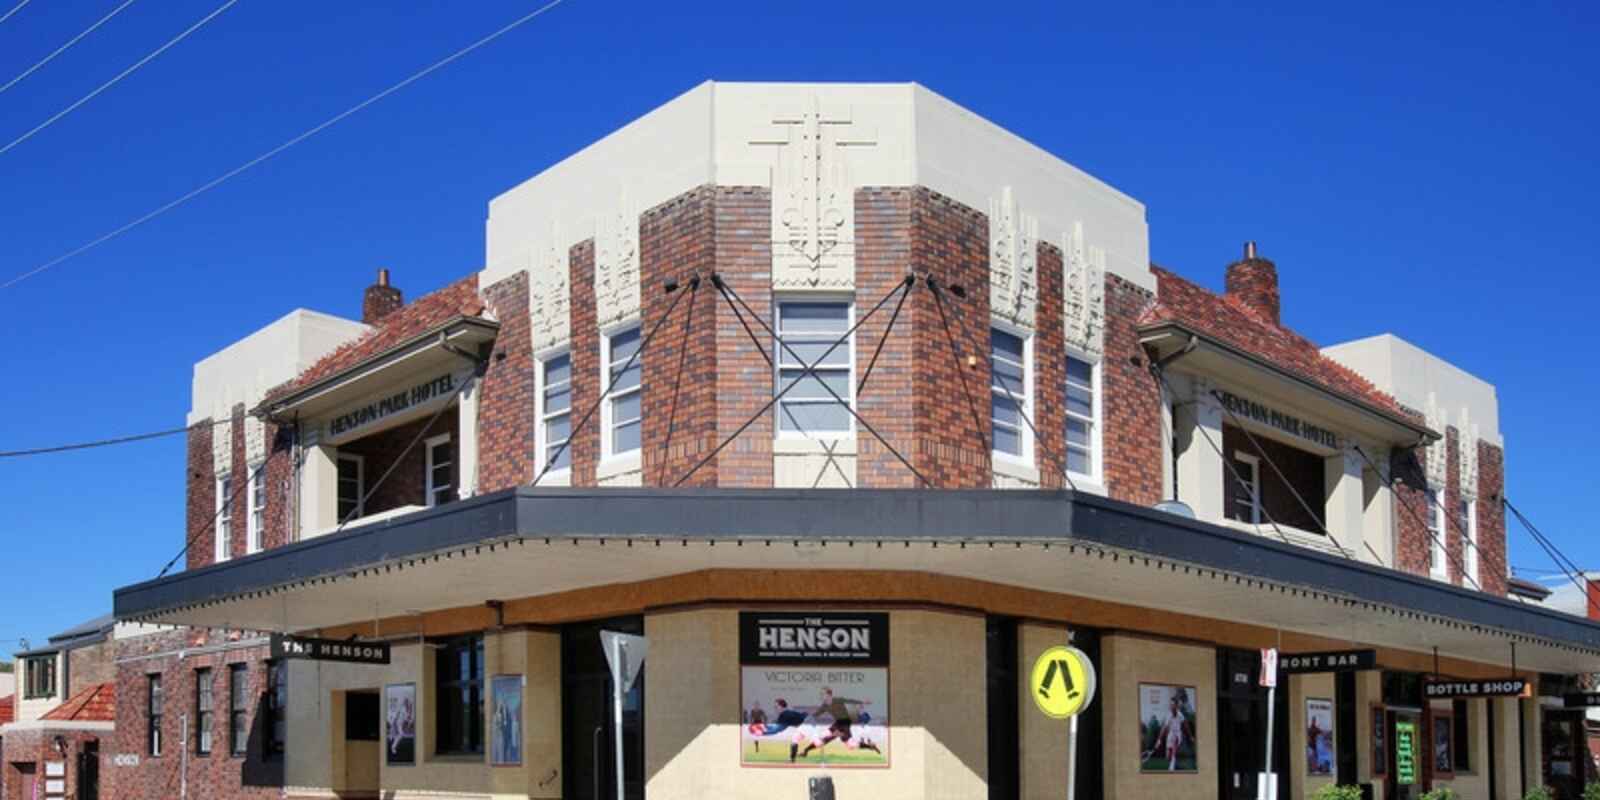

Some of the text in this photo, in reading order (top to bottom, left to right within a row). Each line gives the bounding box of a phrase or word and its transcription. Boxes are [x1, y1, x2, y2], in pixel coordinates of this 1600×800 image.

[330, 403, 377, 436] HENSON
[411, 373, 454, 406] HOTEL
[804, 618, 822, 626] THE
[759, 627, 870, 650] HENSON
[282, 641, 383, 659] THE HENSON
[1280, 655, 1358, 669] RONT BAR
[764, 671, 865, 684] VICTORIA BITTER
[1426, 681, 1523, 695] BOTTLE SHOP
